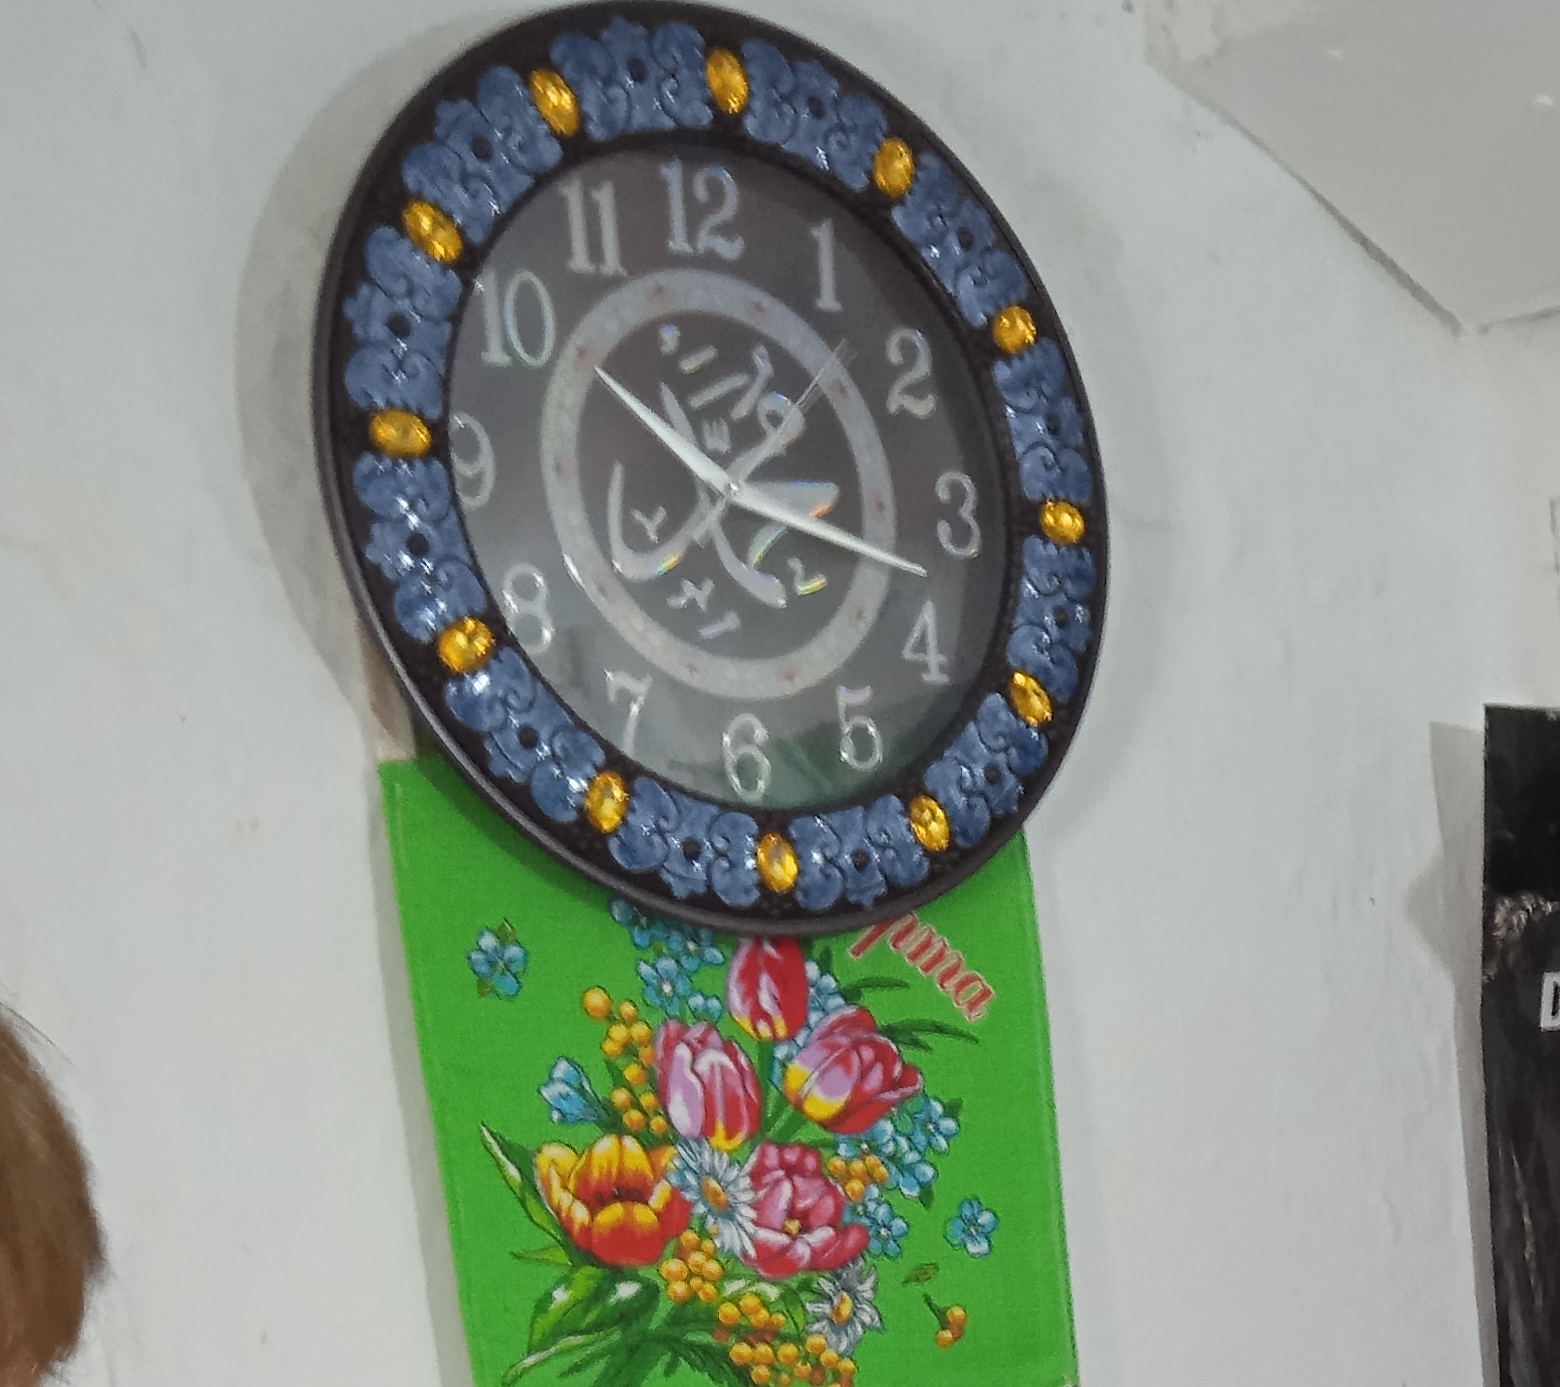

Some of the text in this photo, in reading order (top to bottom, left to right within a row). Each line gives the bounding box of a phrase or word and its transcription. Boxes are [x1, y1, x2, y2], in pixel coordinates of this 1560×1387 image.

[560, 180, 628, 279] 11
[659, 156, 746, 262] 12
[809, 220, 843, 312] 1
[480, 269, 557, 369] 10
[885, 328, 937, 417] 2
[447, 411, 496, 509] 9
[935, 472, 983, 560] 3
[502, 562, 556, 656] 8
[902, 598, 950, 687] 4
[604, 668, 649, 757] 7
[720, 712, 772, 801] 6
[836, 684, 884, 771] 5
